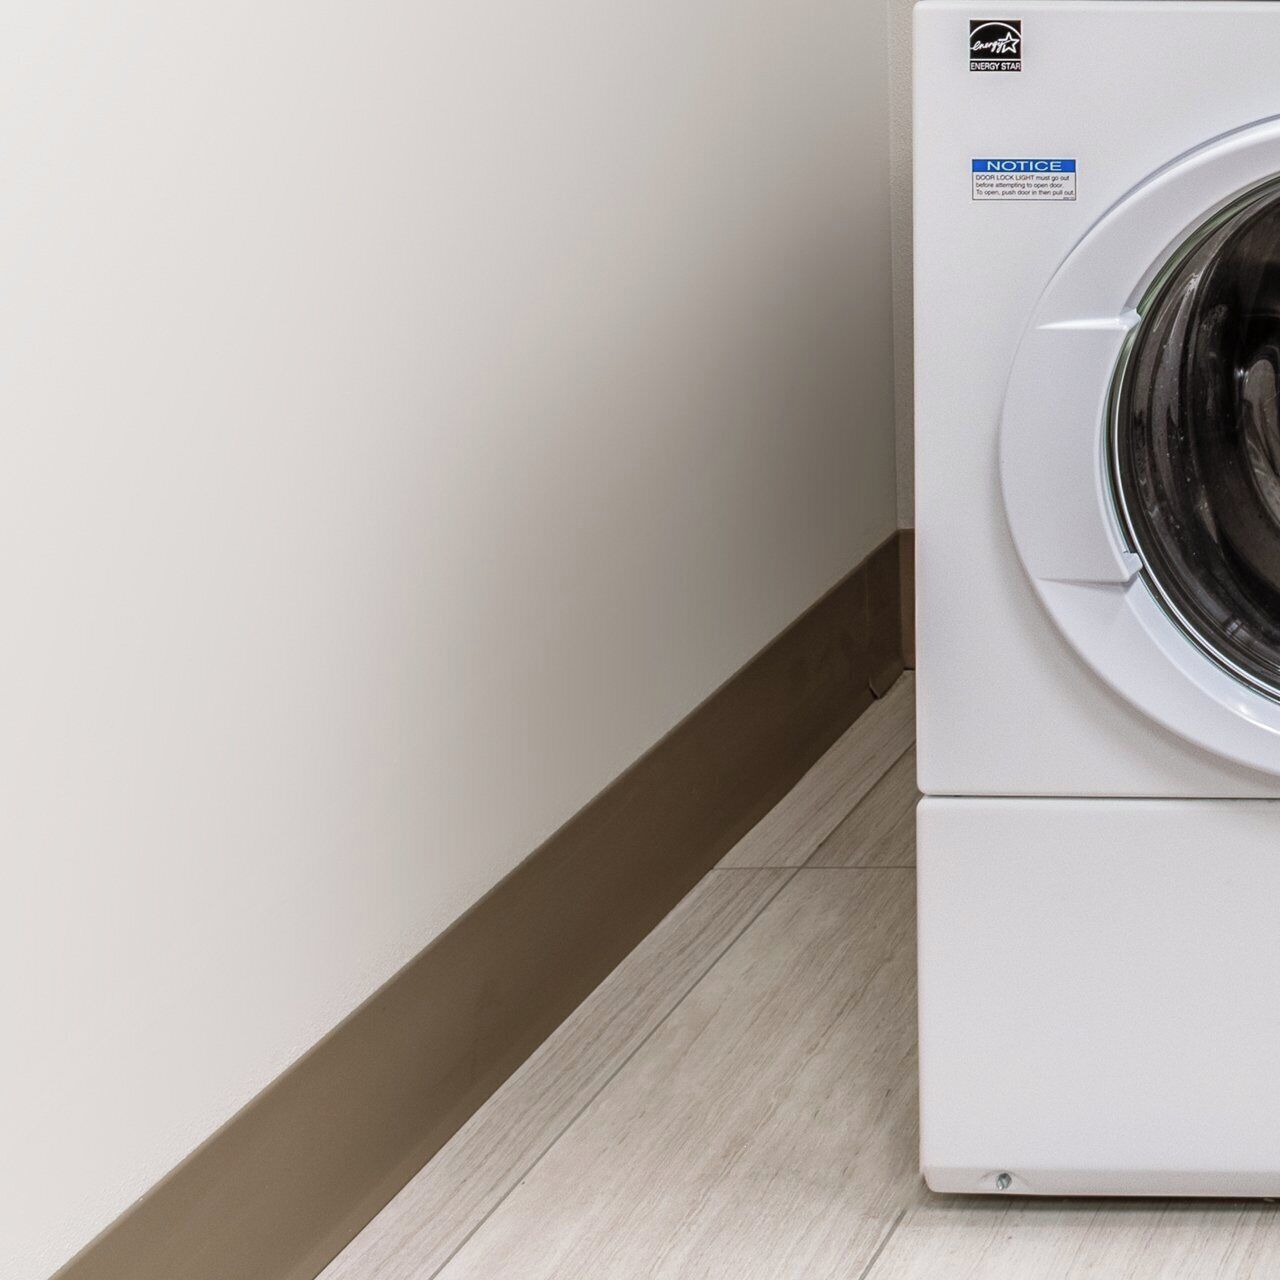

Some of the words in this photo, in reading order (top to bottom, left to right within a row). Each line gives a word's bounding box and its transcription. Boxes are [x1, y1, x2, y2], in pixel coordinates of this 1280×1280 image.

[971, 62, 1000, 70] ENERGY
[1001, 62, 1020, 70] STAR
[987, 161, 1061, 171] NOTICE
